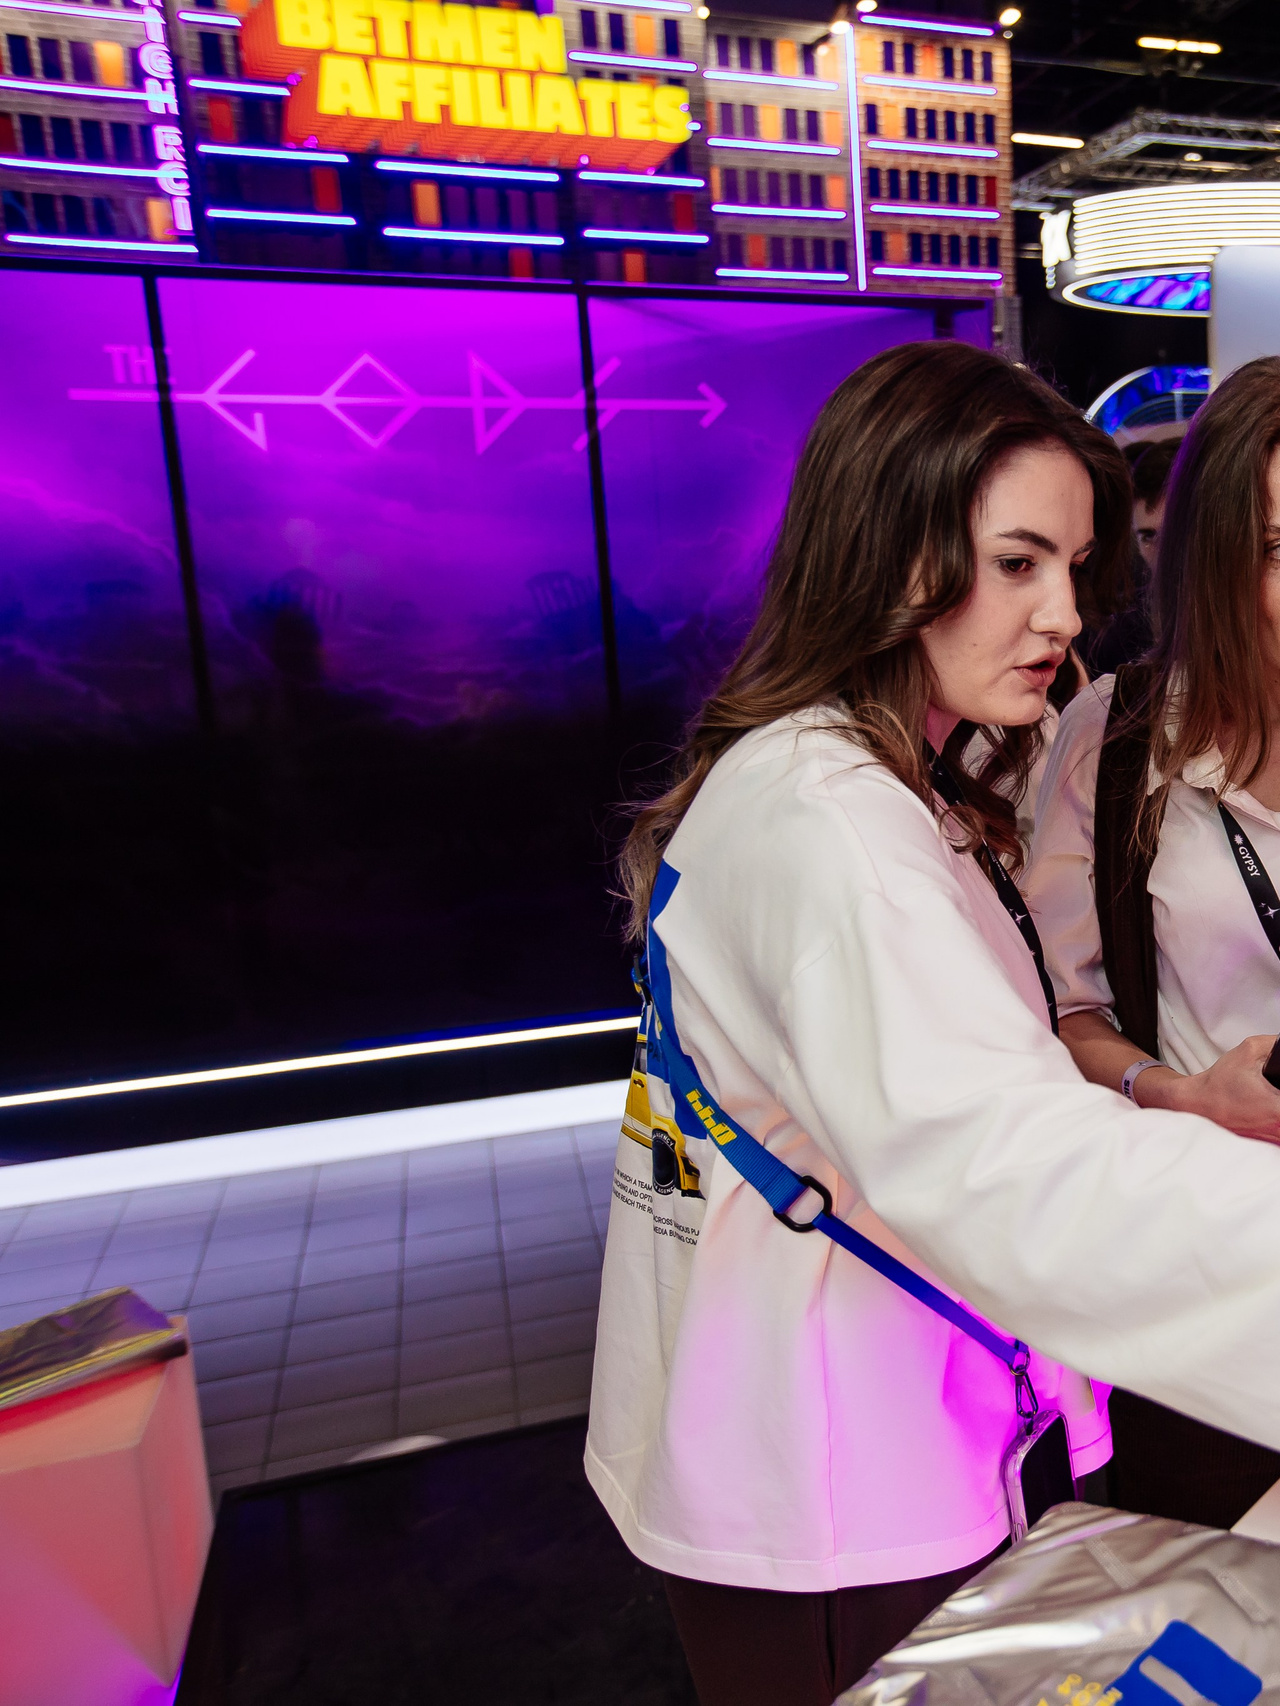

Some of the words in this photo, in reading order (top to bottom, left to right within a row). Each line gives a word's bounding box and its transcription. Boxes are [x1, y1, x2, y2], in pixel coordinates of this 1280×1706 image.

[274, 0, 567, 73] BETMEN
[317, 54, 693, 143] AFFILIATES
[103, 344, 177, 385] TH
[1239, 846, 1261, 877] GYPSY
[1123, 1079, 1131, 1100] SIL
[628, 1187, 639, 1198] AND
[636, 1202, 647, 1212] THE
